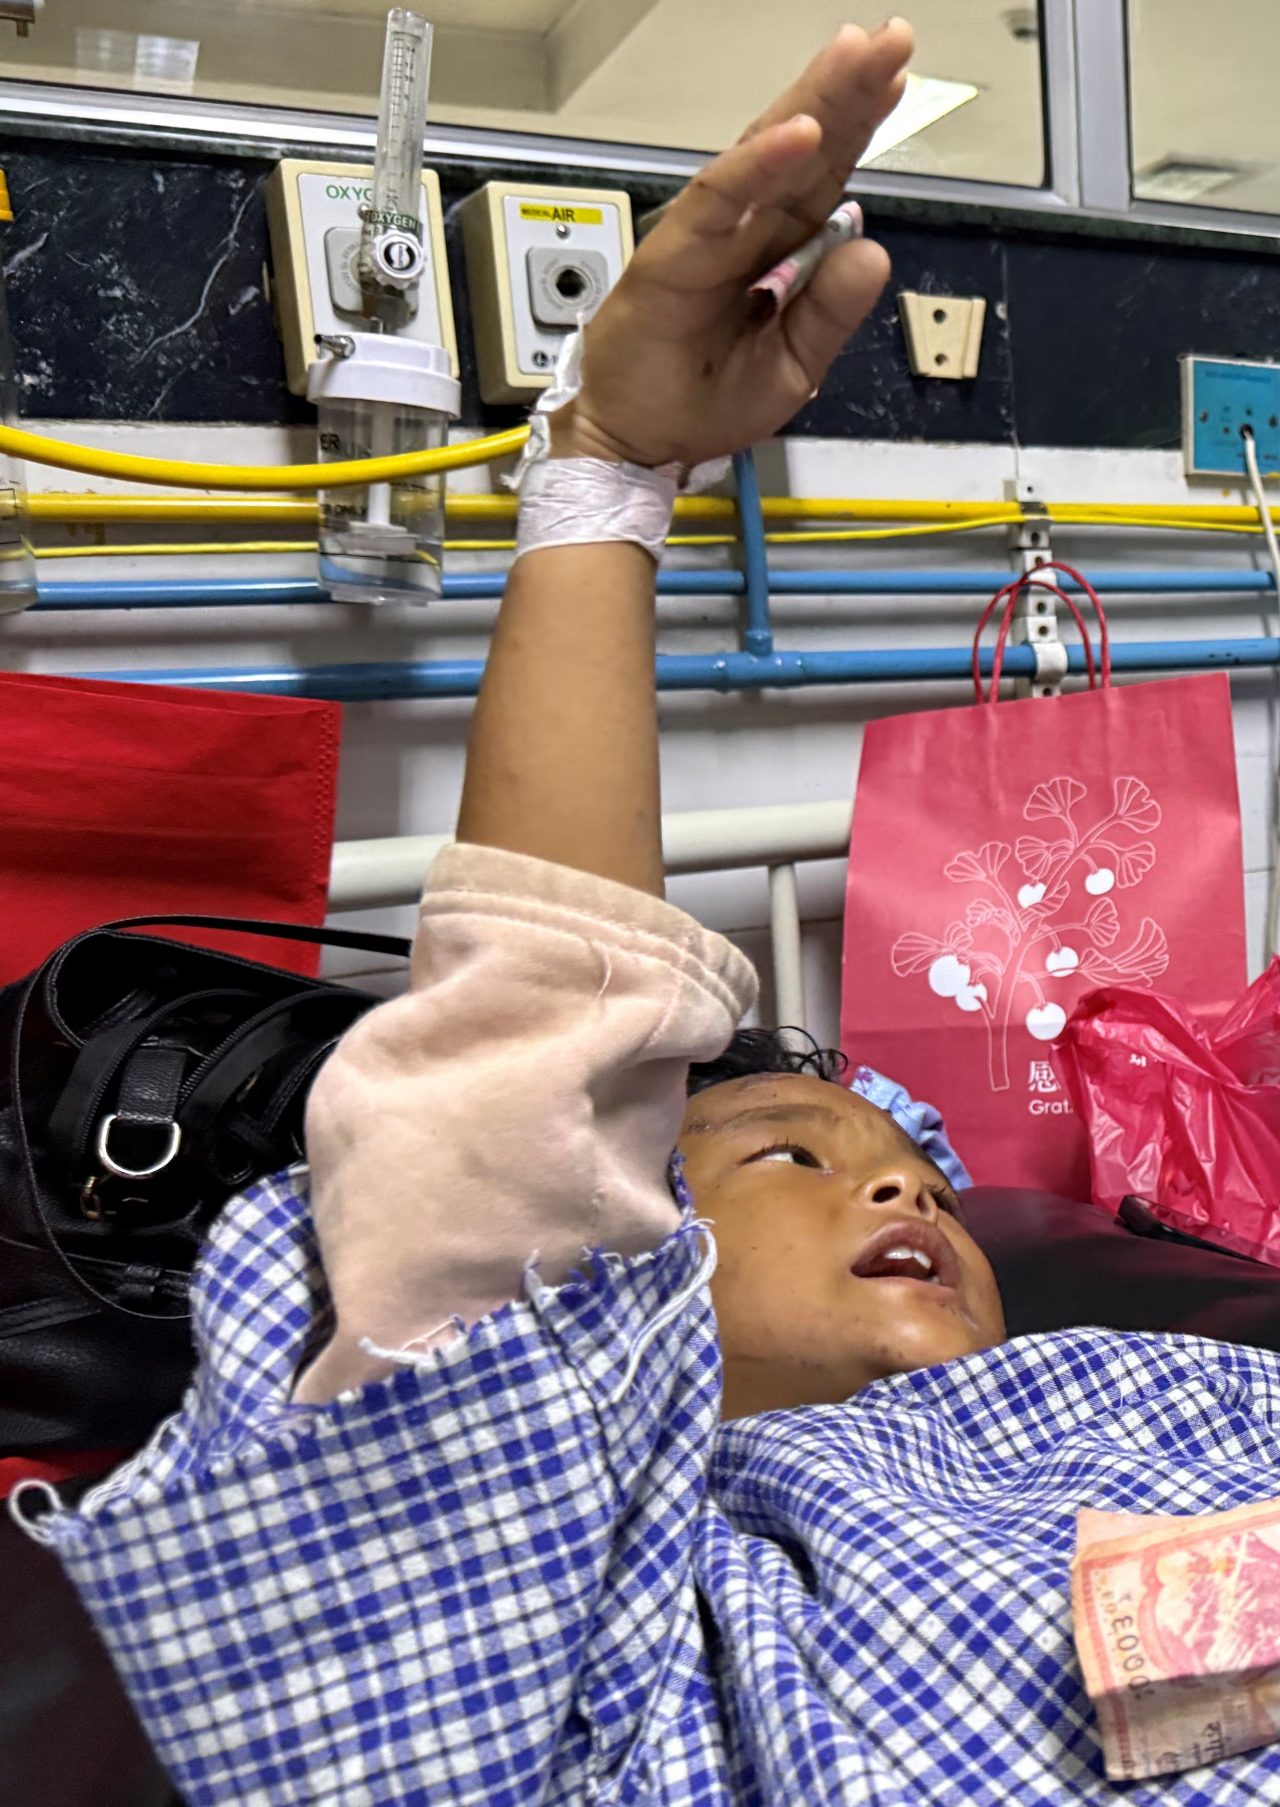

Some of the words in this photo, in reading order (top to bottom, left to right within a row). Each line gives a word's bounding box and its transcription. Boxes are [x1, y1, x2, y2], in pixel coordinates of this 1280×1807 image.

[326, 185, 374, 202] OXYG
[371, 211, 417, 230] OXYGEN
[552, 207, 576, 223] AIR
[1029, 1099, 1073, 1116] Grat
